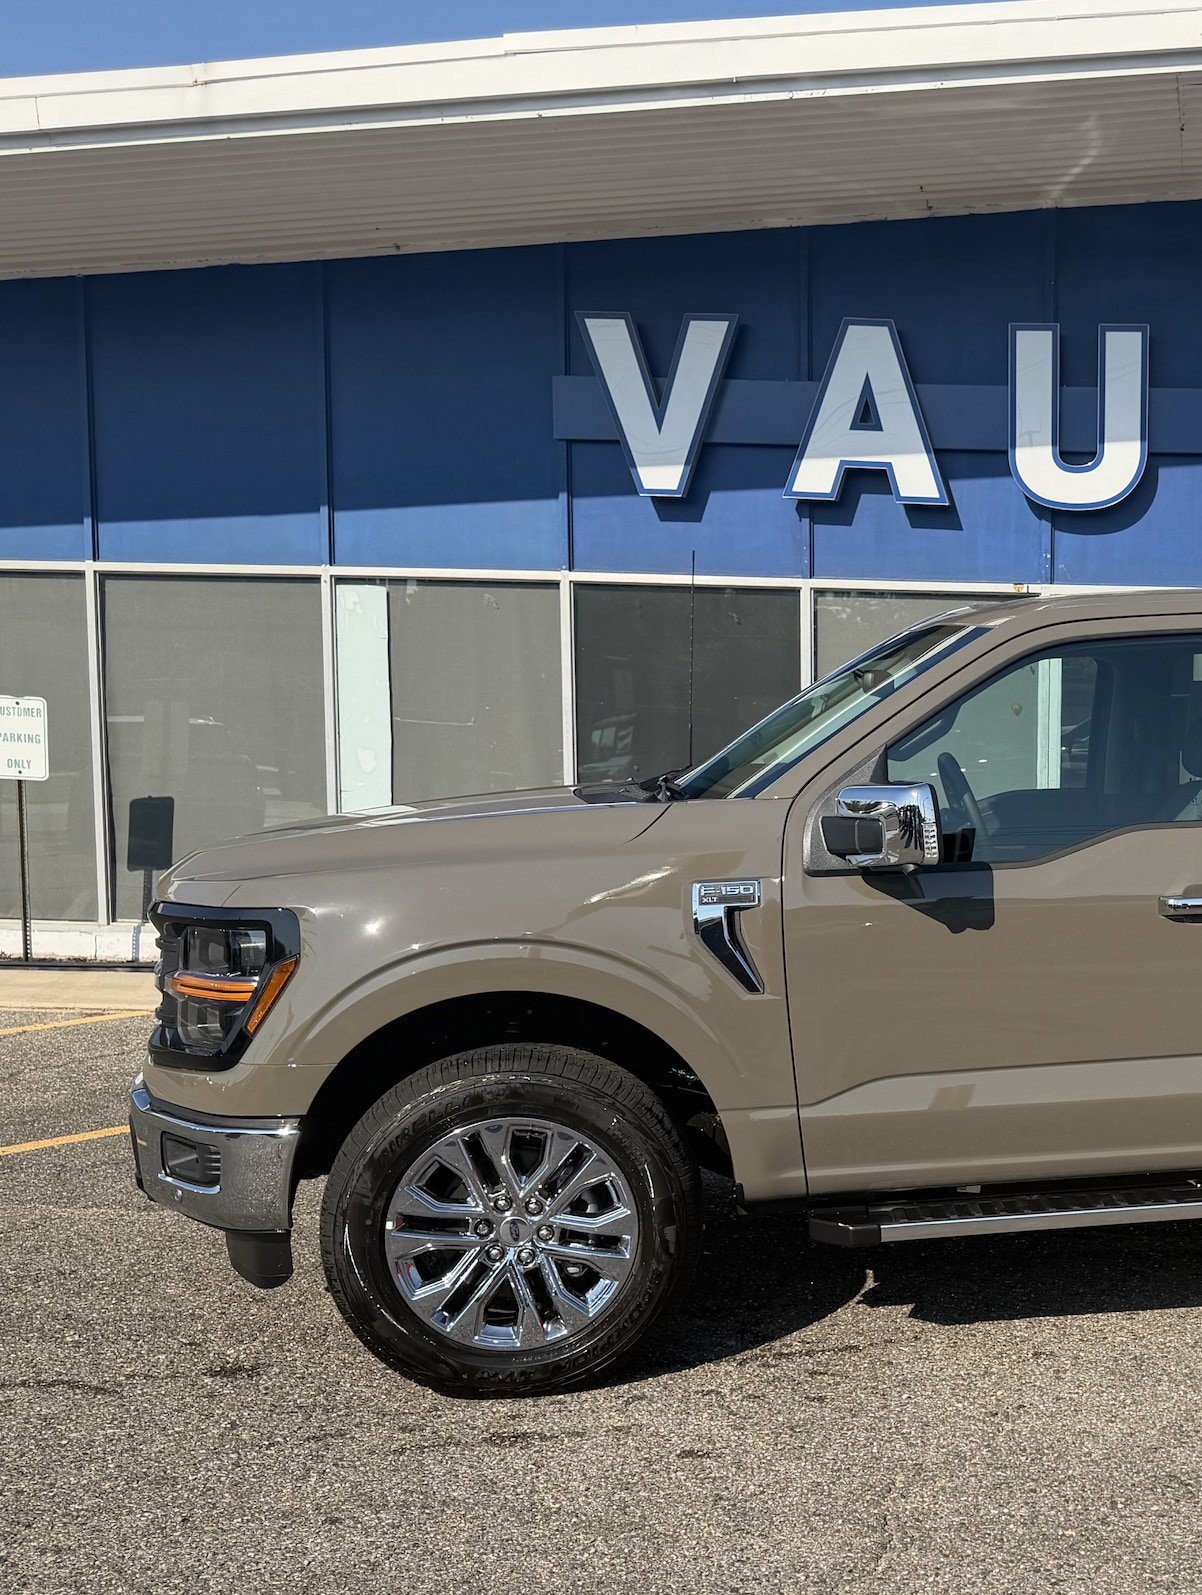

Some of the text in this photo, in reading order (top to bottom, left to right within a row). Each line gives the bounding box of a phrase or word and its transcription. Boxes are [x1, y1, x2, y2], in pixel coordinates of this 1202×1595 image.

[0, 706, 42, 718] USTOMER
[7, 758, 32, 770] ONLY
[700, 885, 754, 896] F-150
[702, 896, 719, 904] XLT
